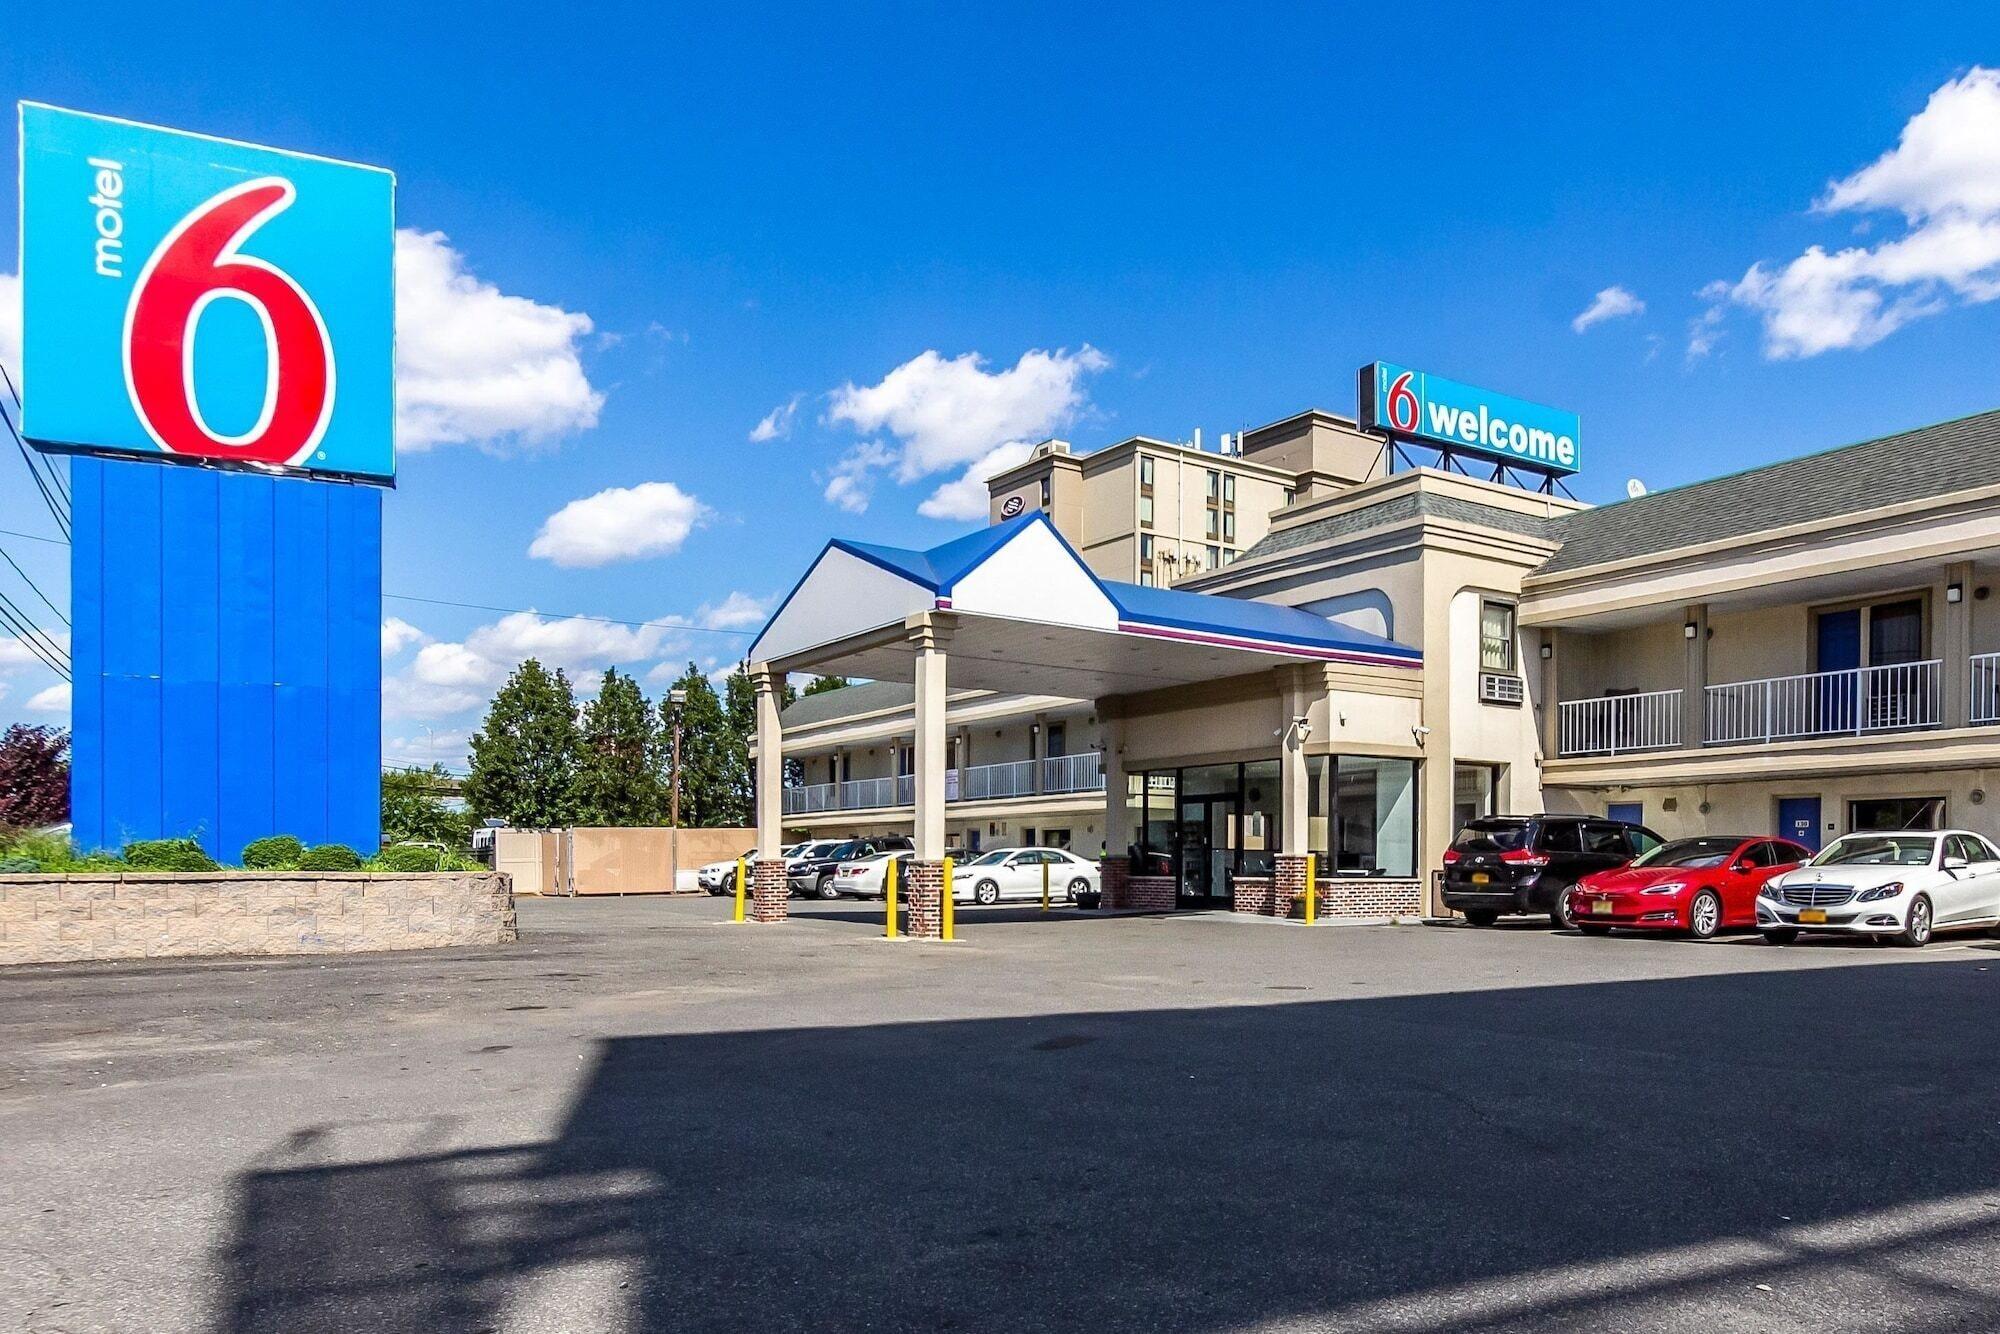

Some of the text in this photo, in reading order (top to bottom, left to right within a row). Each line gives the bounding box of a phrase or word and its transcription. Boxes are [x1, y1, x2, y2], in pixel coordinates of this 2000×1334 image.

[87, 157, 123, 278] motel
[122, 176, 337, 466] 6
[1387, 371, 1420, 433] 6
[1428, 401, 1576, 465] welcome
